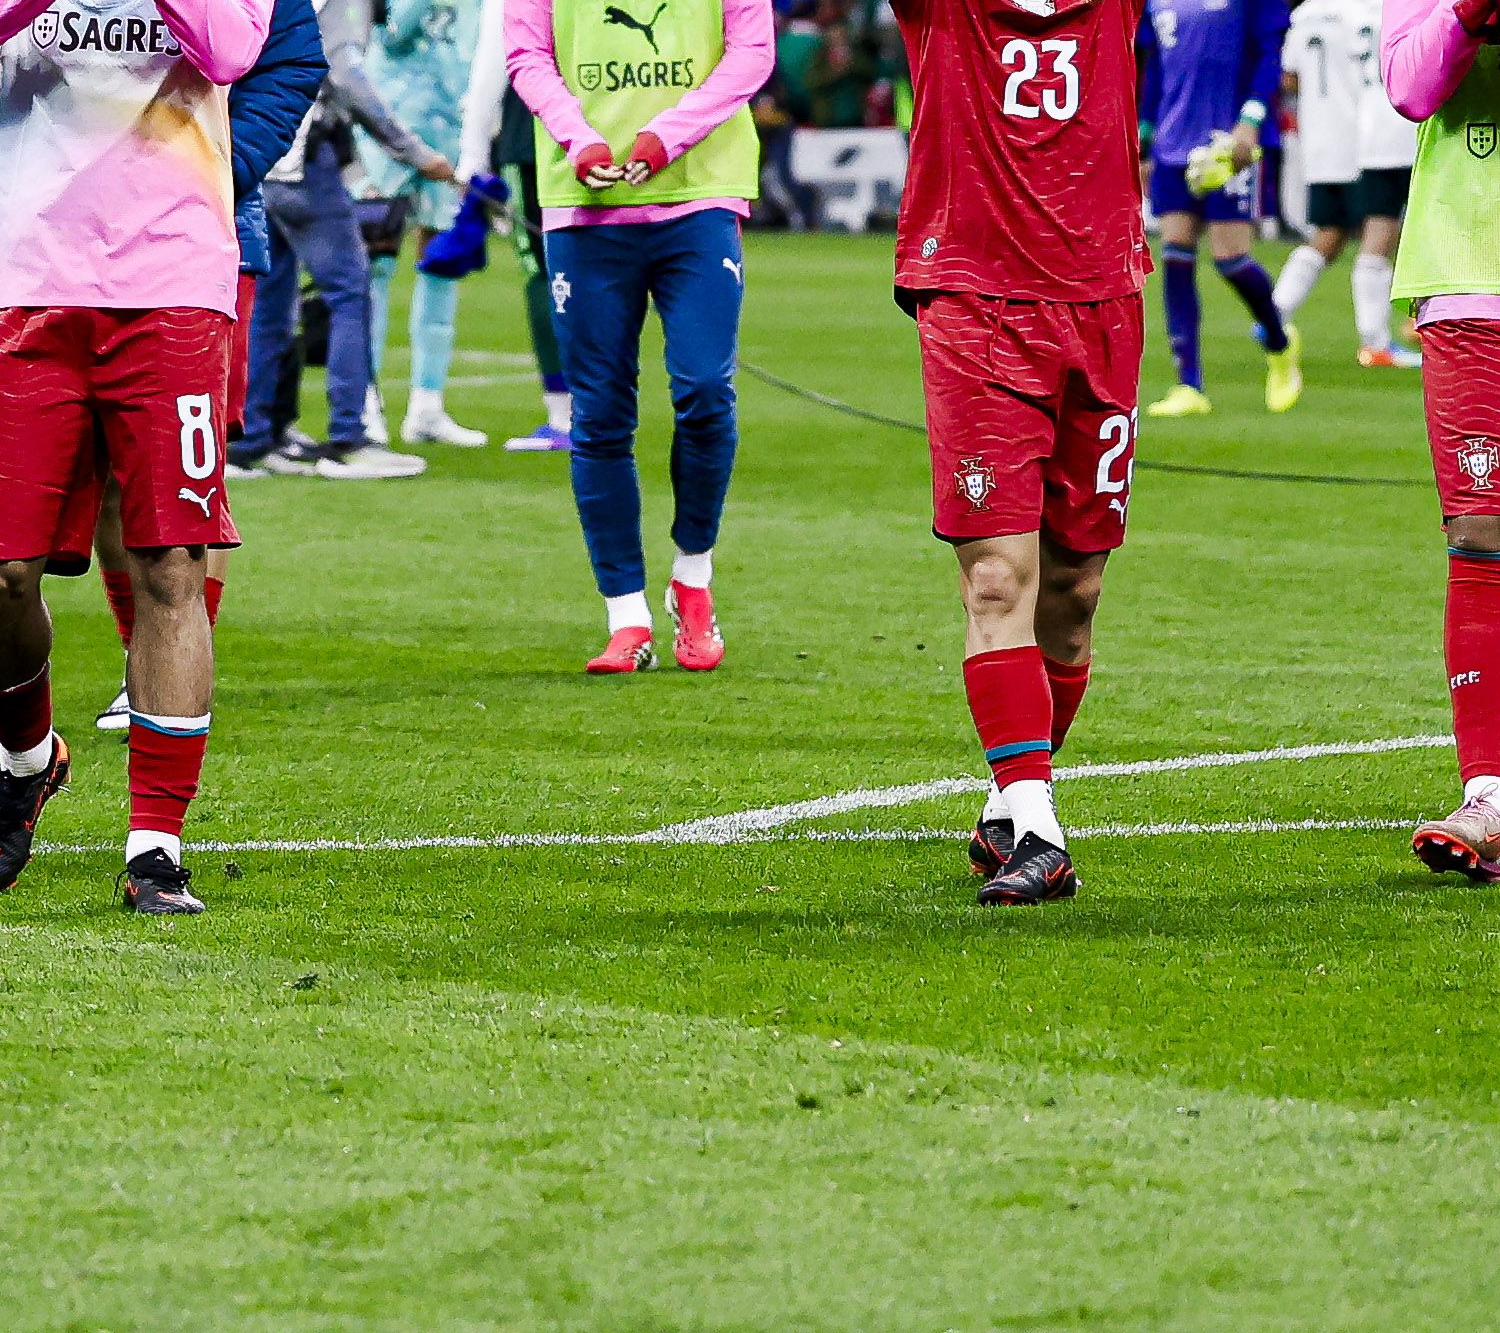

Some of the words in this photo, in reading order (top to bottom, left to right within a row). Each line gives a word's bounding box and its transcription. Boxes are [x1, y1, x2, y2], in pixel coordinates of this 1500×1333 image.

[606, 58, 694, 91] SAGRES
[1001, 39, 1080, 121] 23
[176, 394, 216, 480] 8
